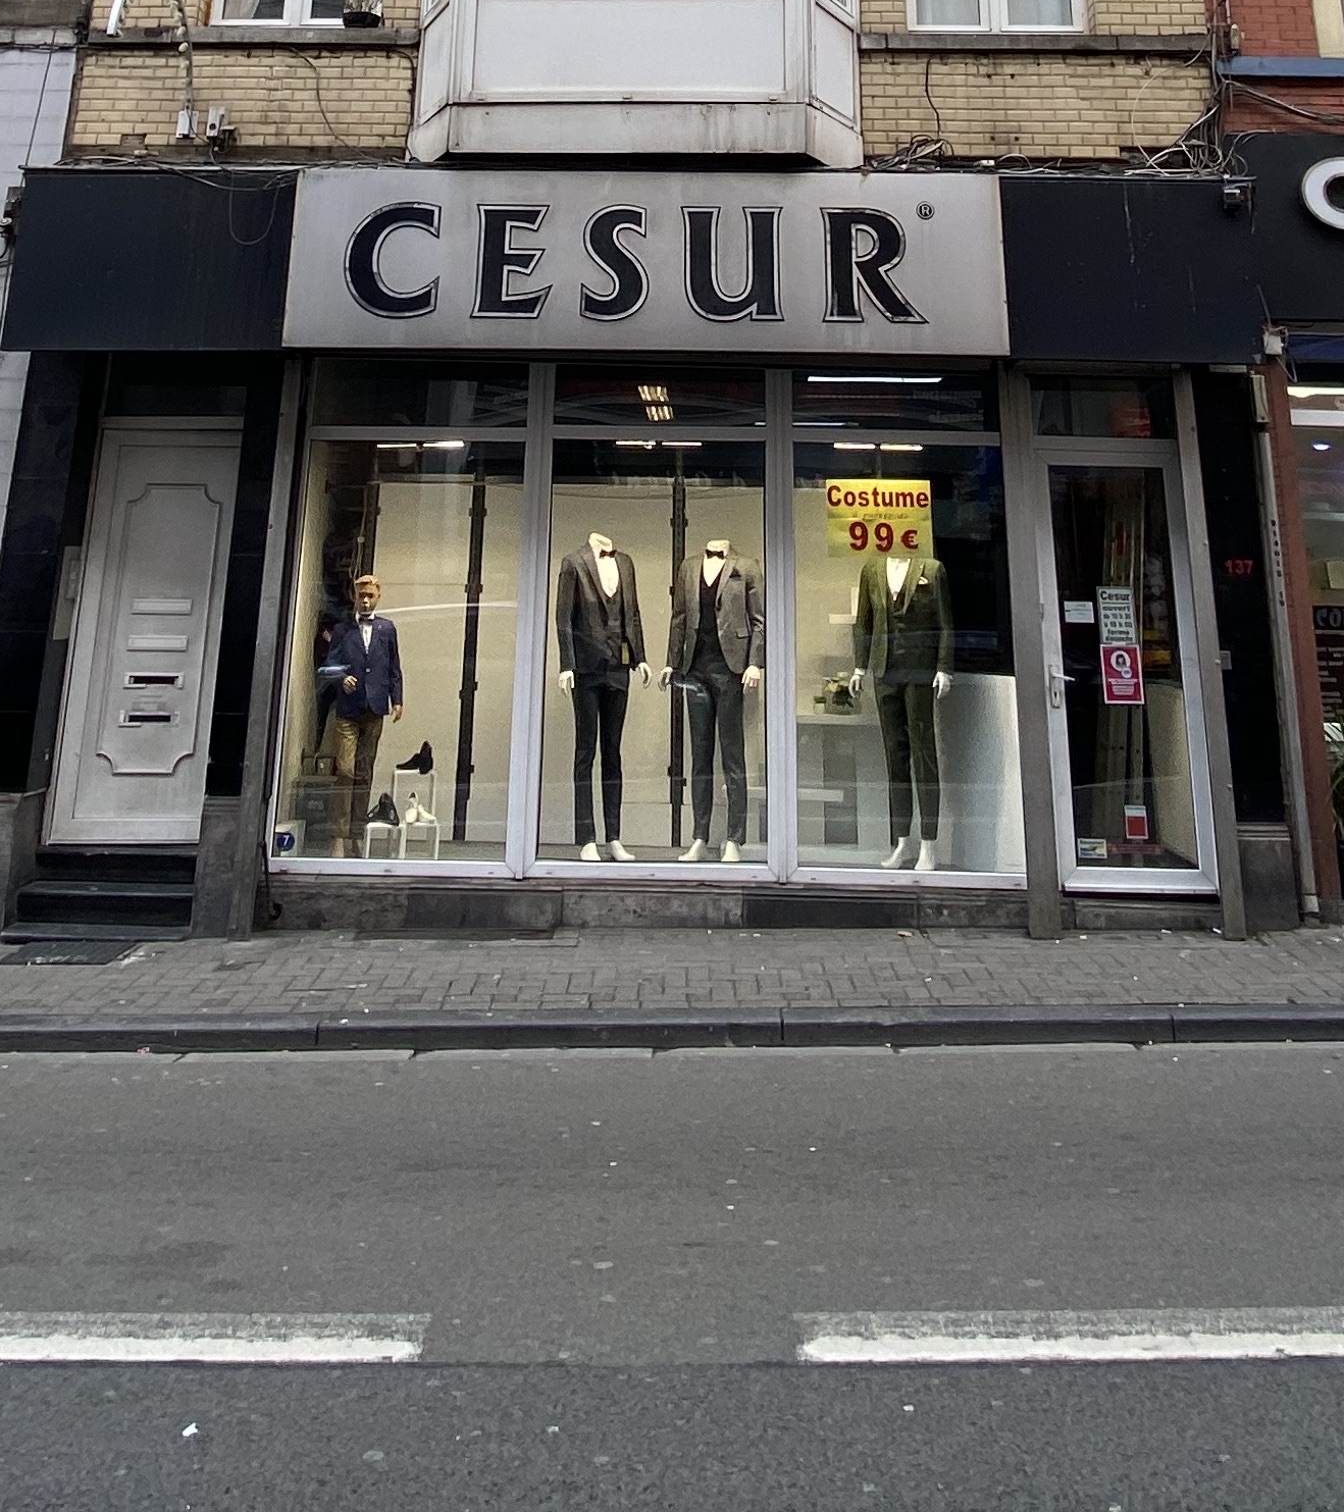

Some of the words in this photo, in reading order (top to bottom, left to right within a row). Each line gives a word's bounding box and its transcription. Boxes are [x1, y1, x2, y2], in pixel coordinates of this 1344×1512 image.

[344, 201, 929, 325] CESUR
[827, 485, 929, 508] Costume
[1224, 559, 1254, 575] 137
[1100, 590, 1130, 601] Cesur
